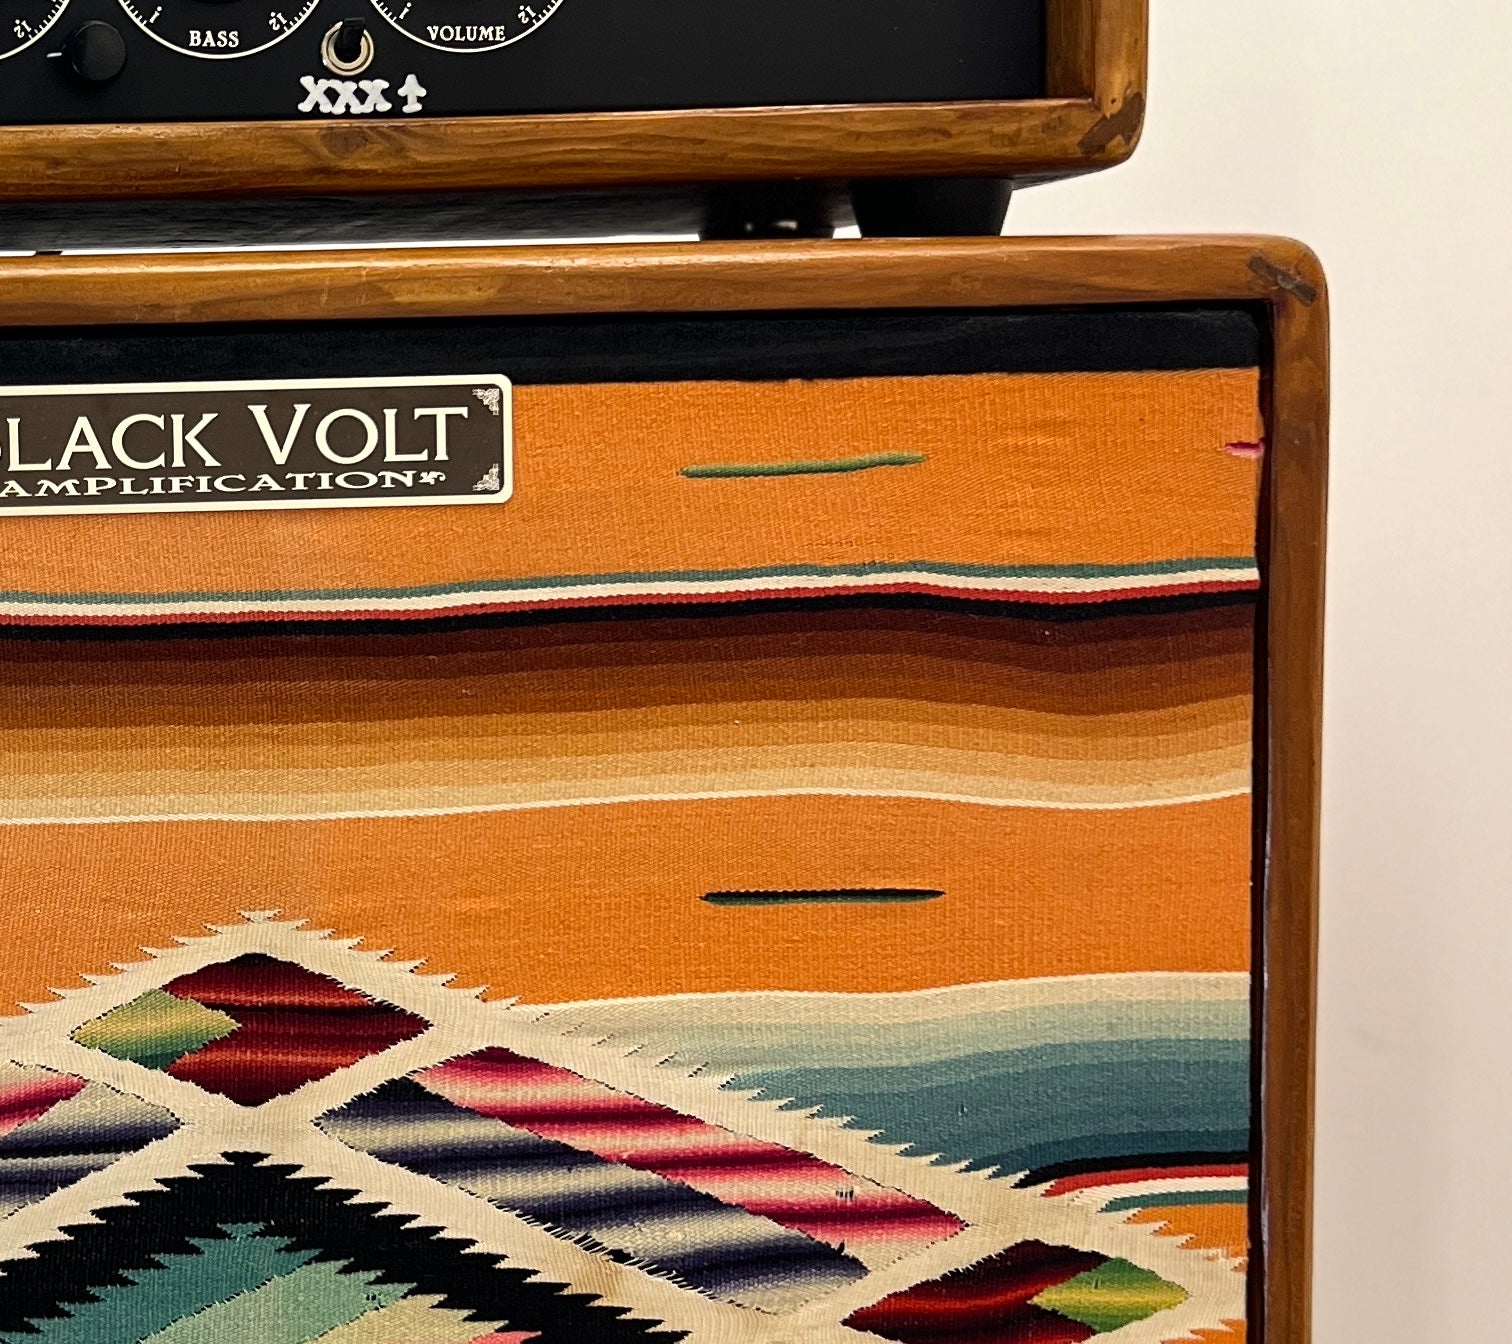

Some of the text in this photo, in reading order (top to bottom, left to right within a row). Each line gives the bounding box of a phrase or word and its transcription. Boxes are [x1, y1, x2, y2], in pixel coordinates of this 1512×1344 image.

[269, 12, 287, 31] 12
[518, 6, 537, 24] 12
[13, 20, 32, 39] 12
[189, 30, 239, 48] BASS
[427, 25, 506, 41] VOLUME
[298, 75, 393, 115] XXX
[248, 404, 469, 465] VOLT
